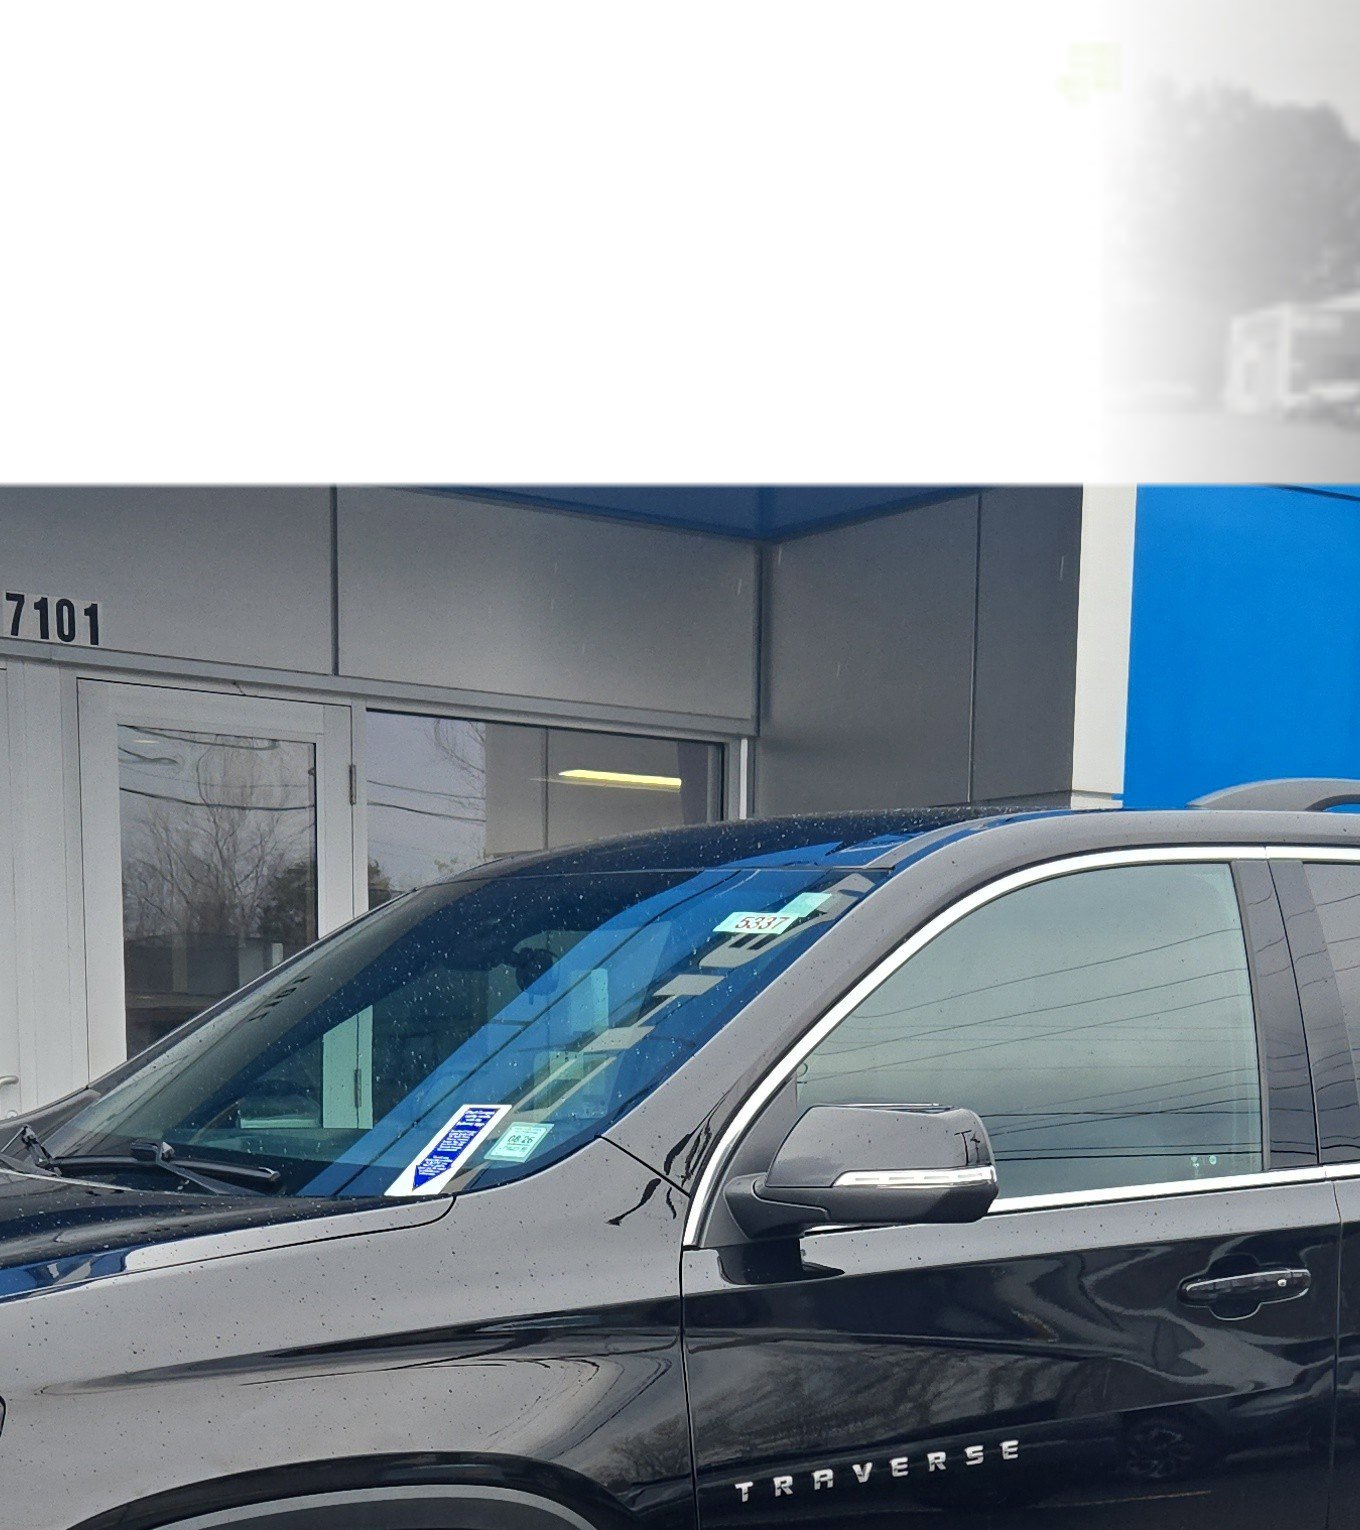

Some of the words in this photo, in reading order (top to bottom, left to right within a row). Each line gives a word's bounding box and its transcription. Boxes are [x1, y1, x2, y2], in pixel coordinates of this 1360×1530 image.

[5, 591, 99, 646] 7101
[735, 916, 789, 930] 5337
[735, 1440, 1019, 1502] TRAVERSE
